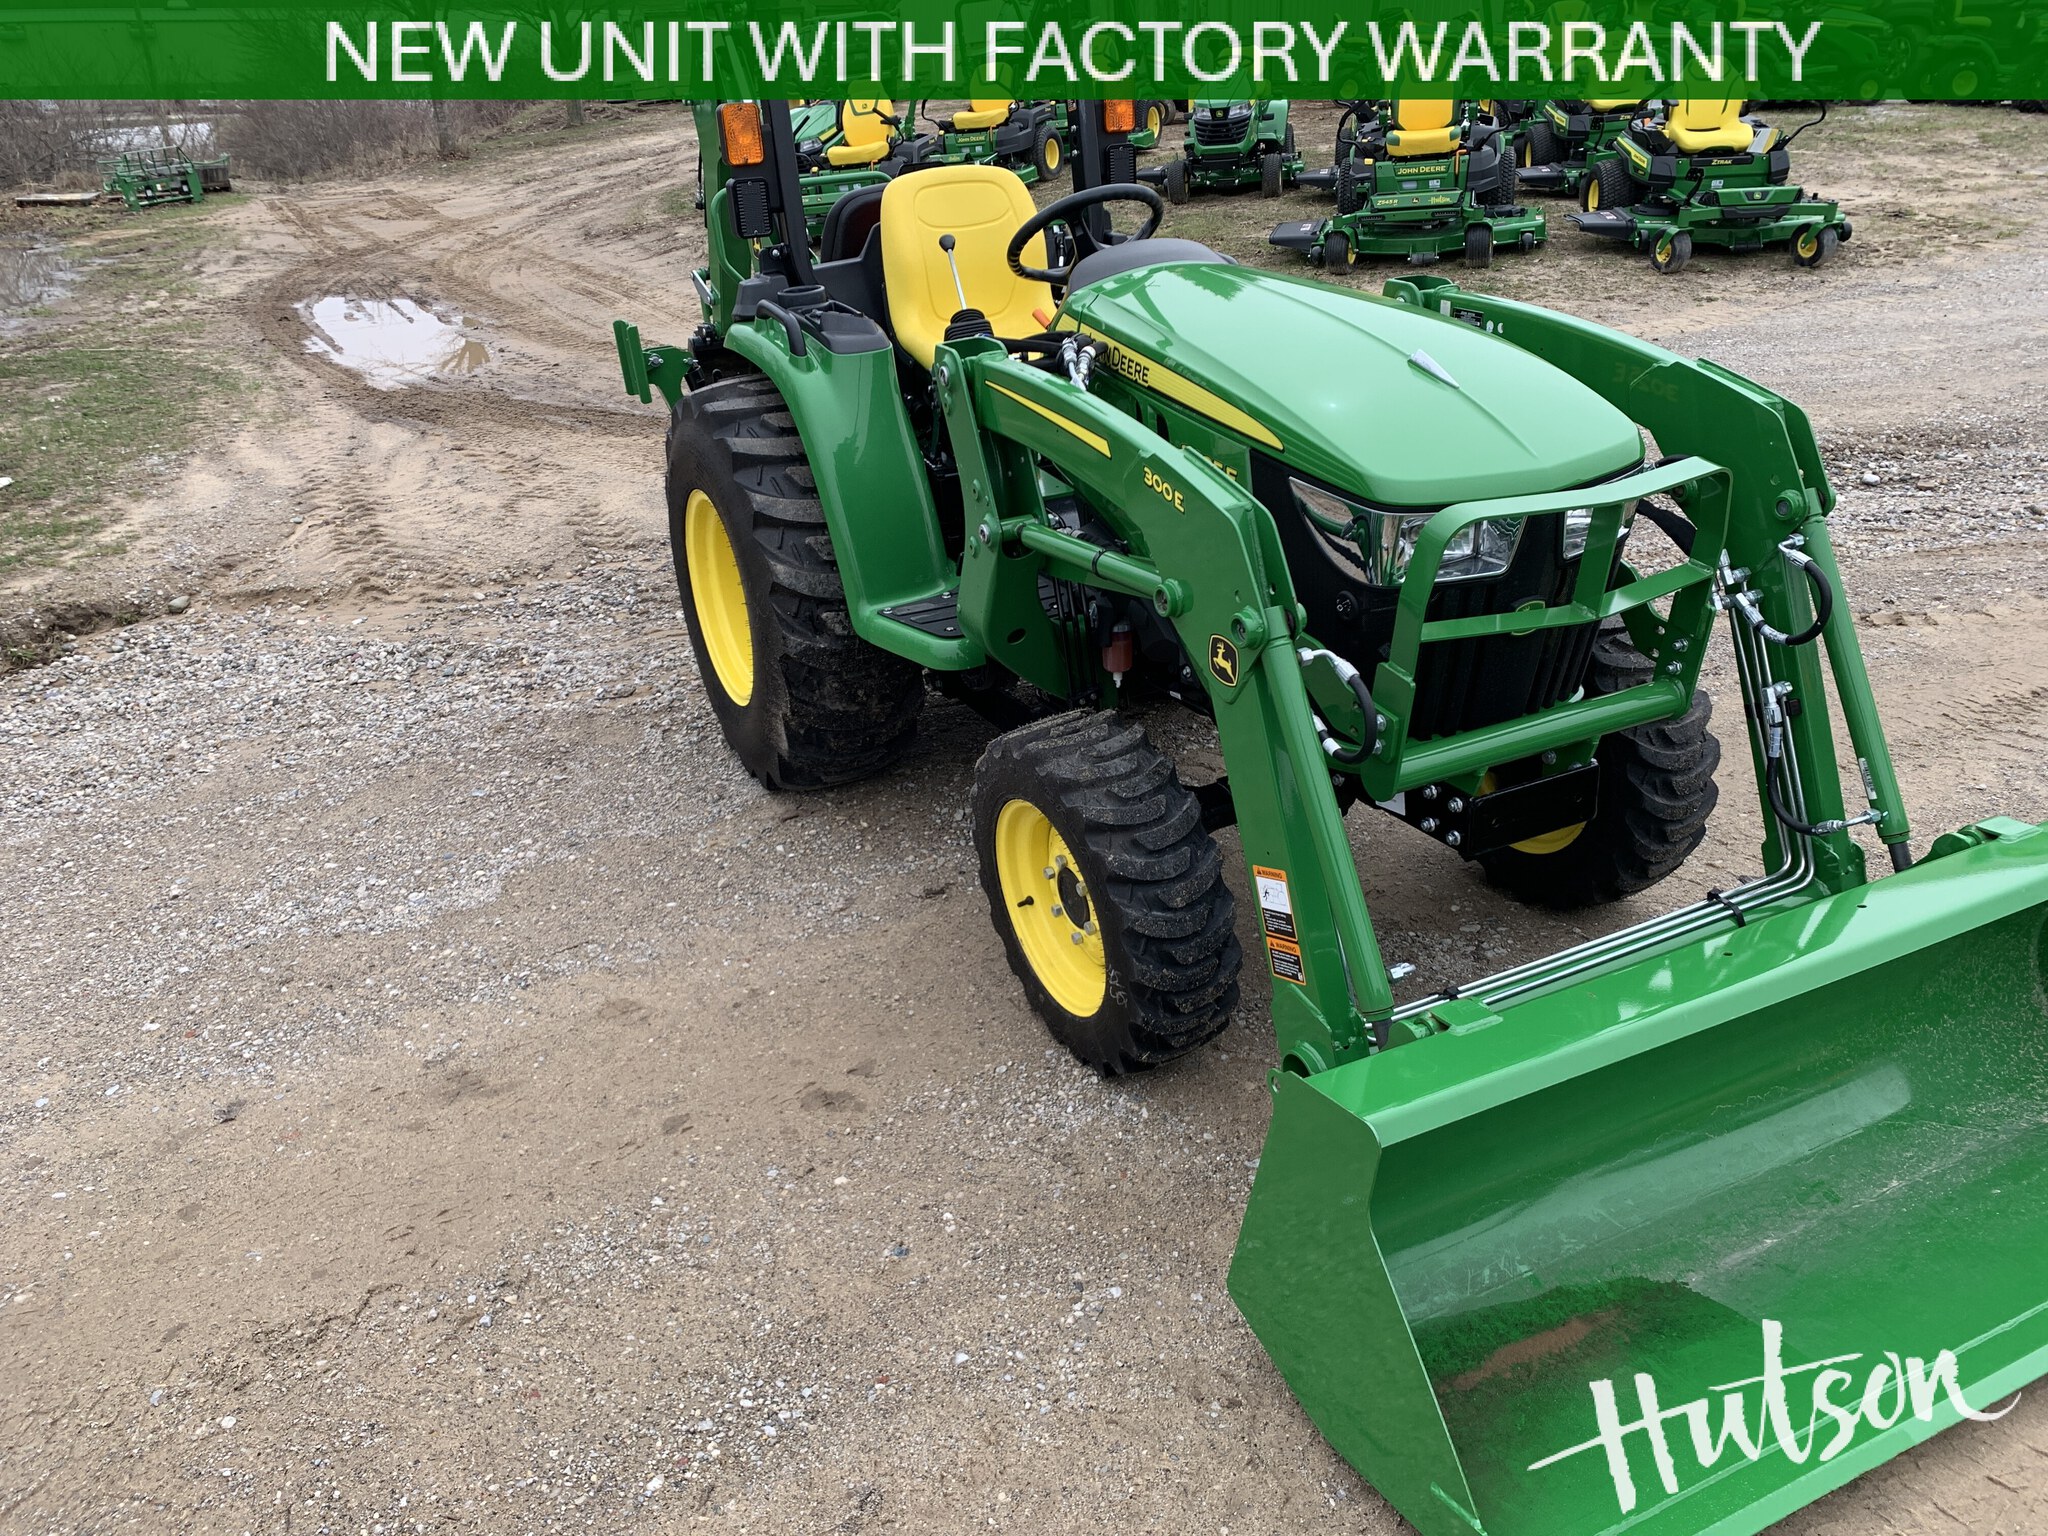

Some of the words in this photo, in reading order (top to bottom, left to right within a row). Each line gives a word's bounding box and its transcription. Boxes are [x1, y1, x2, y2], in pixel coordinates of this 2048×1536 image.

[1397, 167, 1419, 175] JOHN
[1419, 165, 1447, 173] DEERE
[1111, 346, 1150, 385] DEERE
[1143, 466, 1185, 513] 300E
